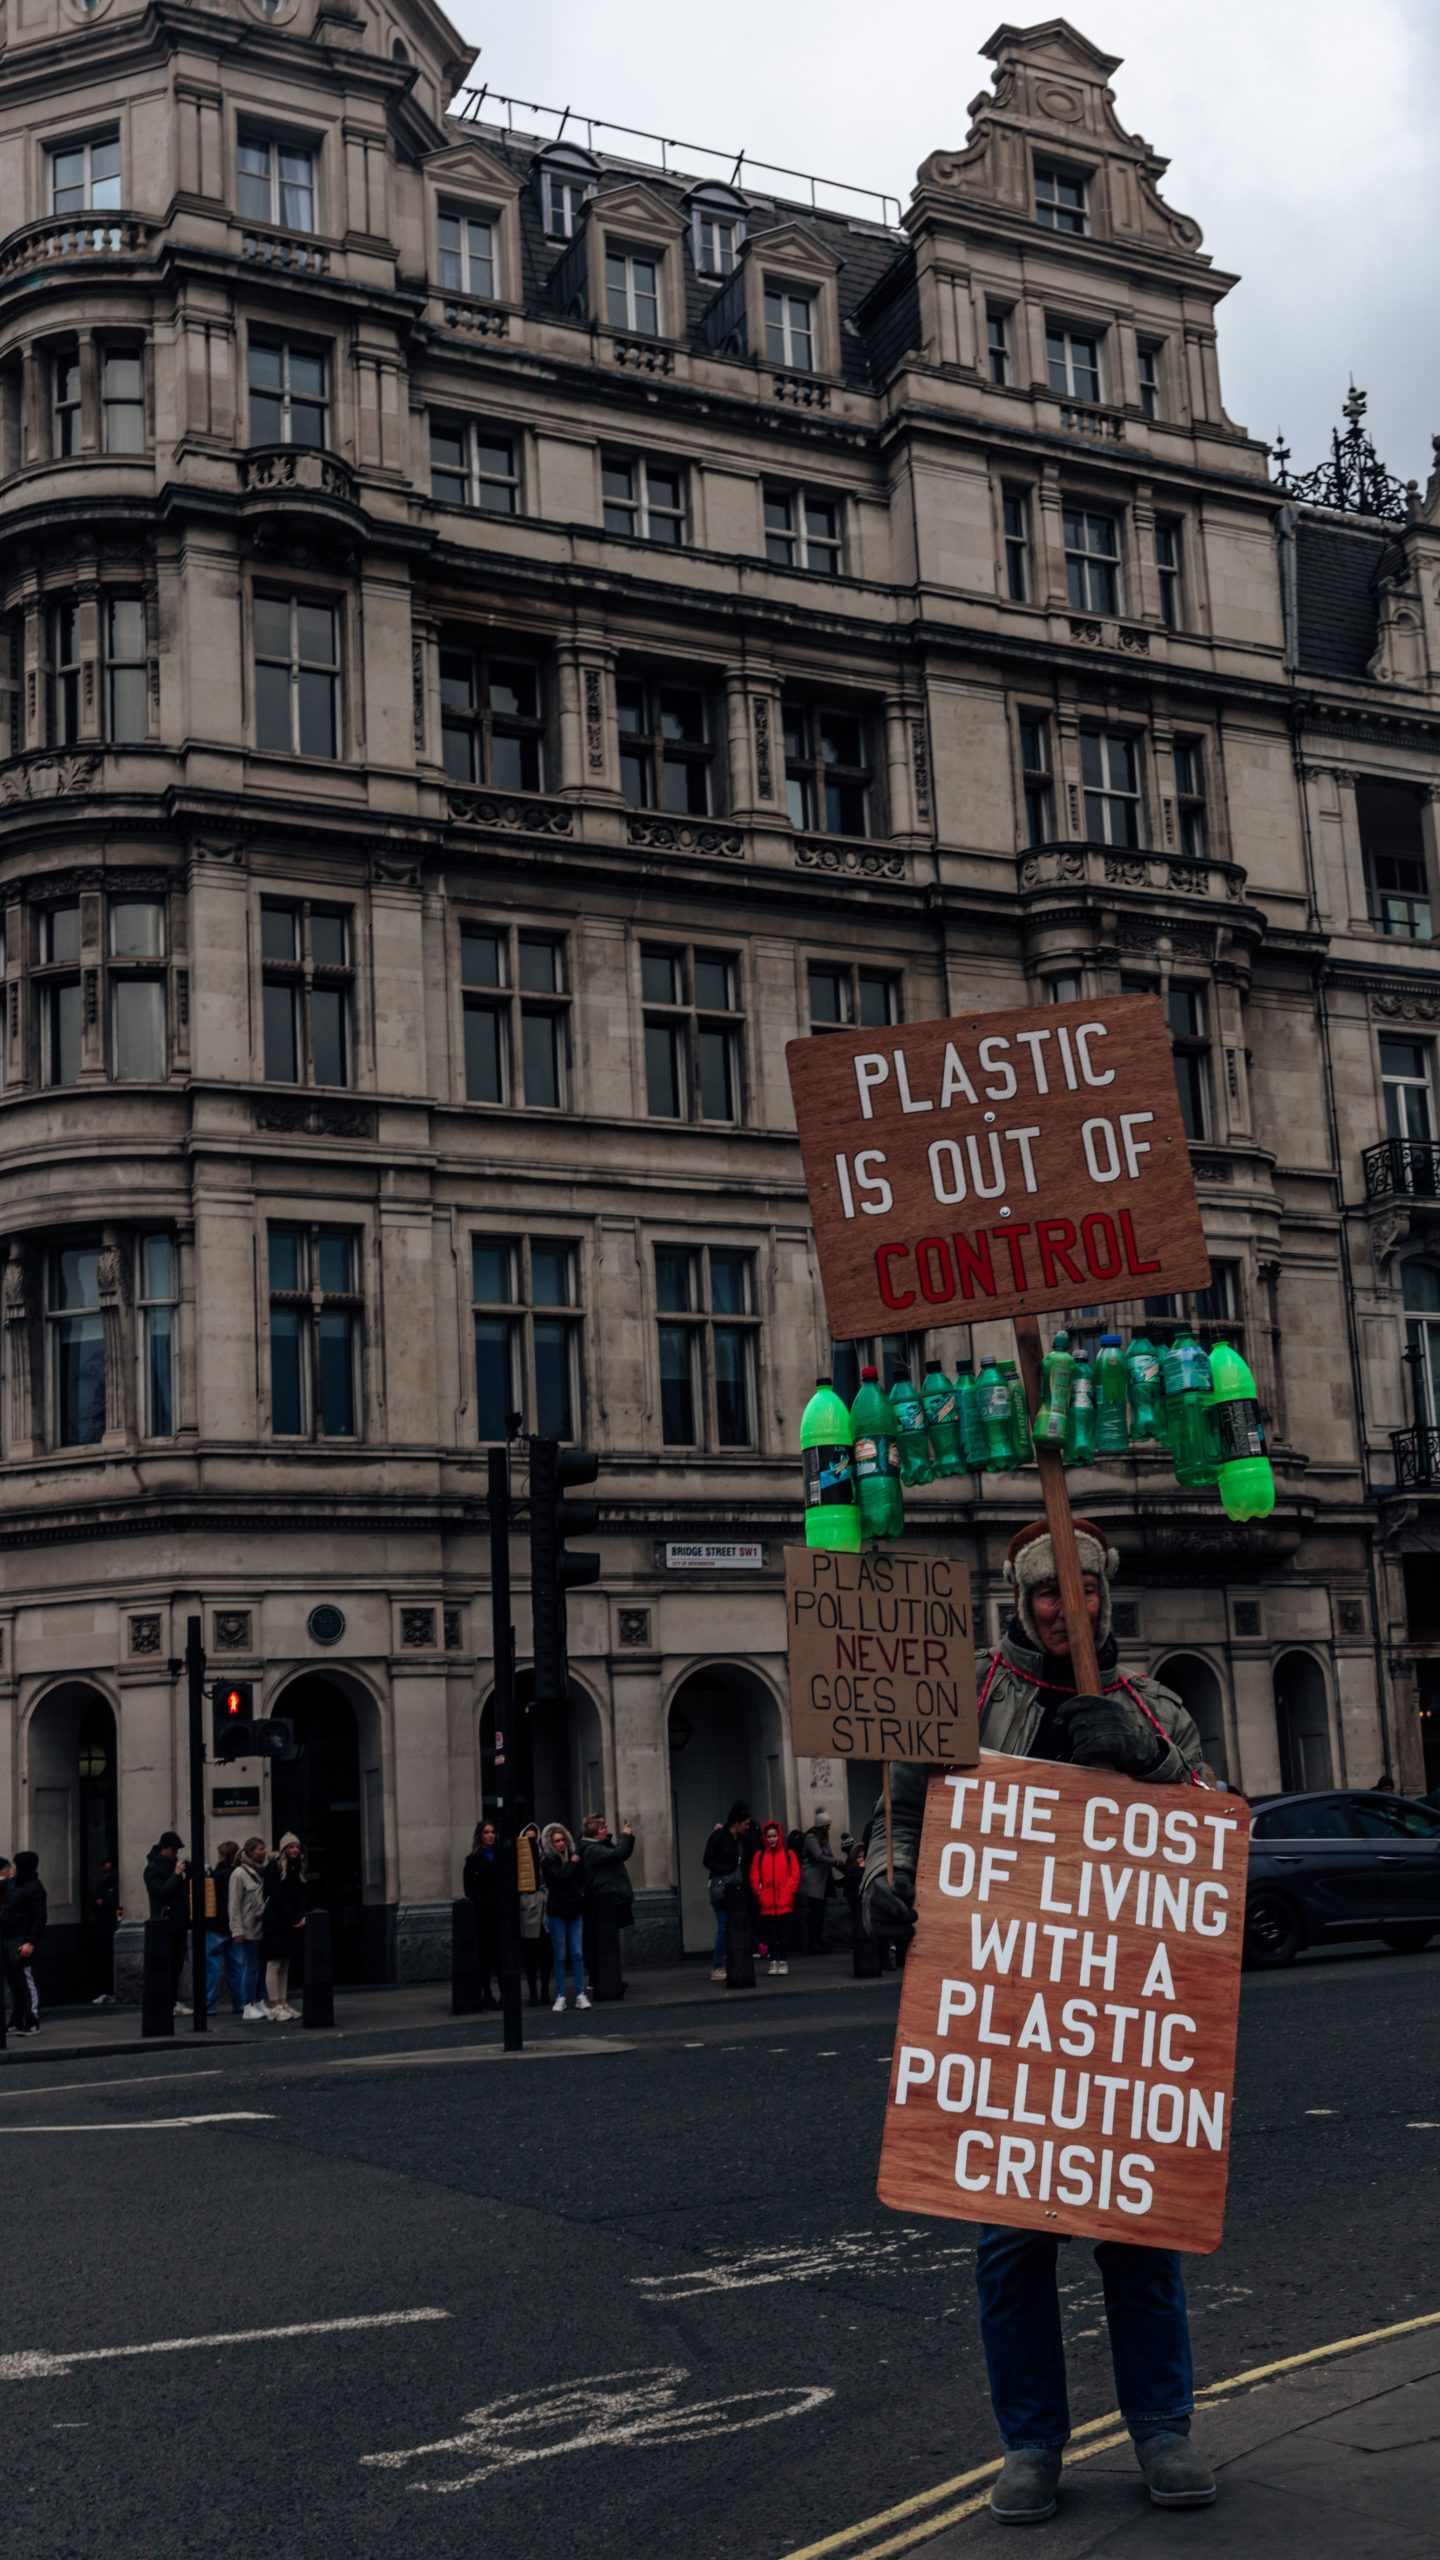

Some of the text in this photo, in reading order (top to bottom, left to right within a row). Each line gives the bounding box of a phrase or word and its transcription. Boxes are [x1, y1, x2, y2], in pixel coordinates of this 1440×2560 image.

[854, 1022, 1115, 1119] PLASTIC
[836, 1111, 1154, 1218] IS OUT OF
[876, 1209, 1160, 1309] CONTROL
[671, 1546, 758, 1557] BRIDGE STREET SW1
[812, 1554, 953, 1597] PLASTIC
[794, 1590, 968, 1638] POLLUTION
[836, 1634, 949, 1677] NEVER
[811, 1673, 959, 1718] GOES ON
[832, 1715, 955, 1758] STRIKE
[944, 1775, 1238, 1871] THE COST
[937, 1841, 1230, 1937] OF LIVING
[969, 1912, 1176, 2001] WITH A
[936, 1978, 1197, 2073] PLASTIC
[894, 2045, 1226, 2152] POLLUTION
[954, 2129, 1156, 2216] CRISIS
